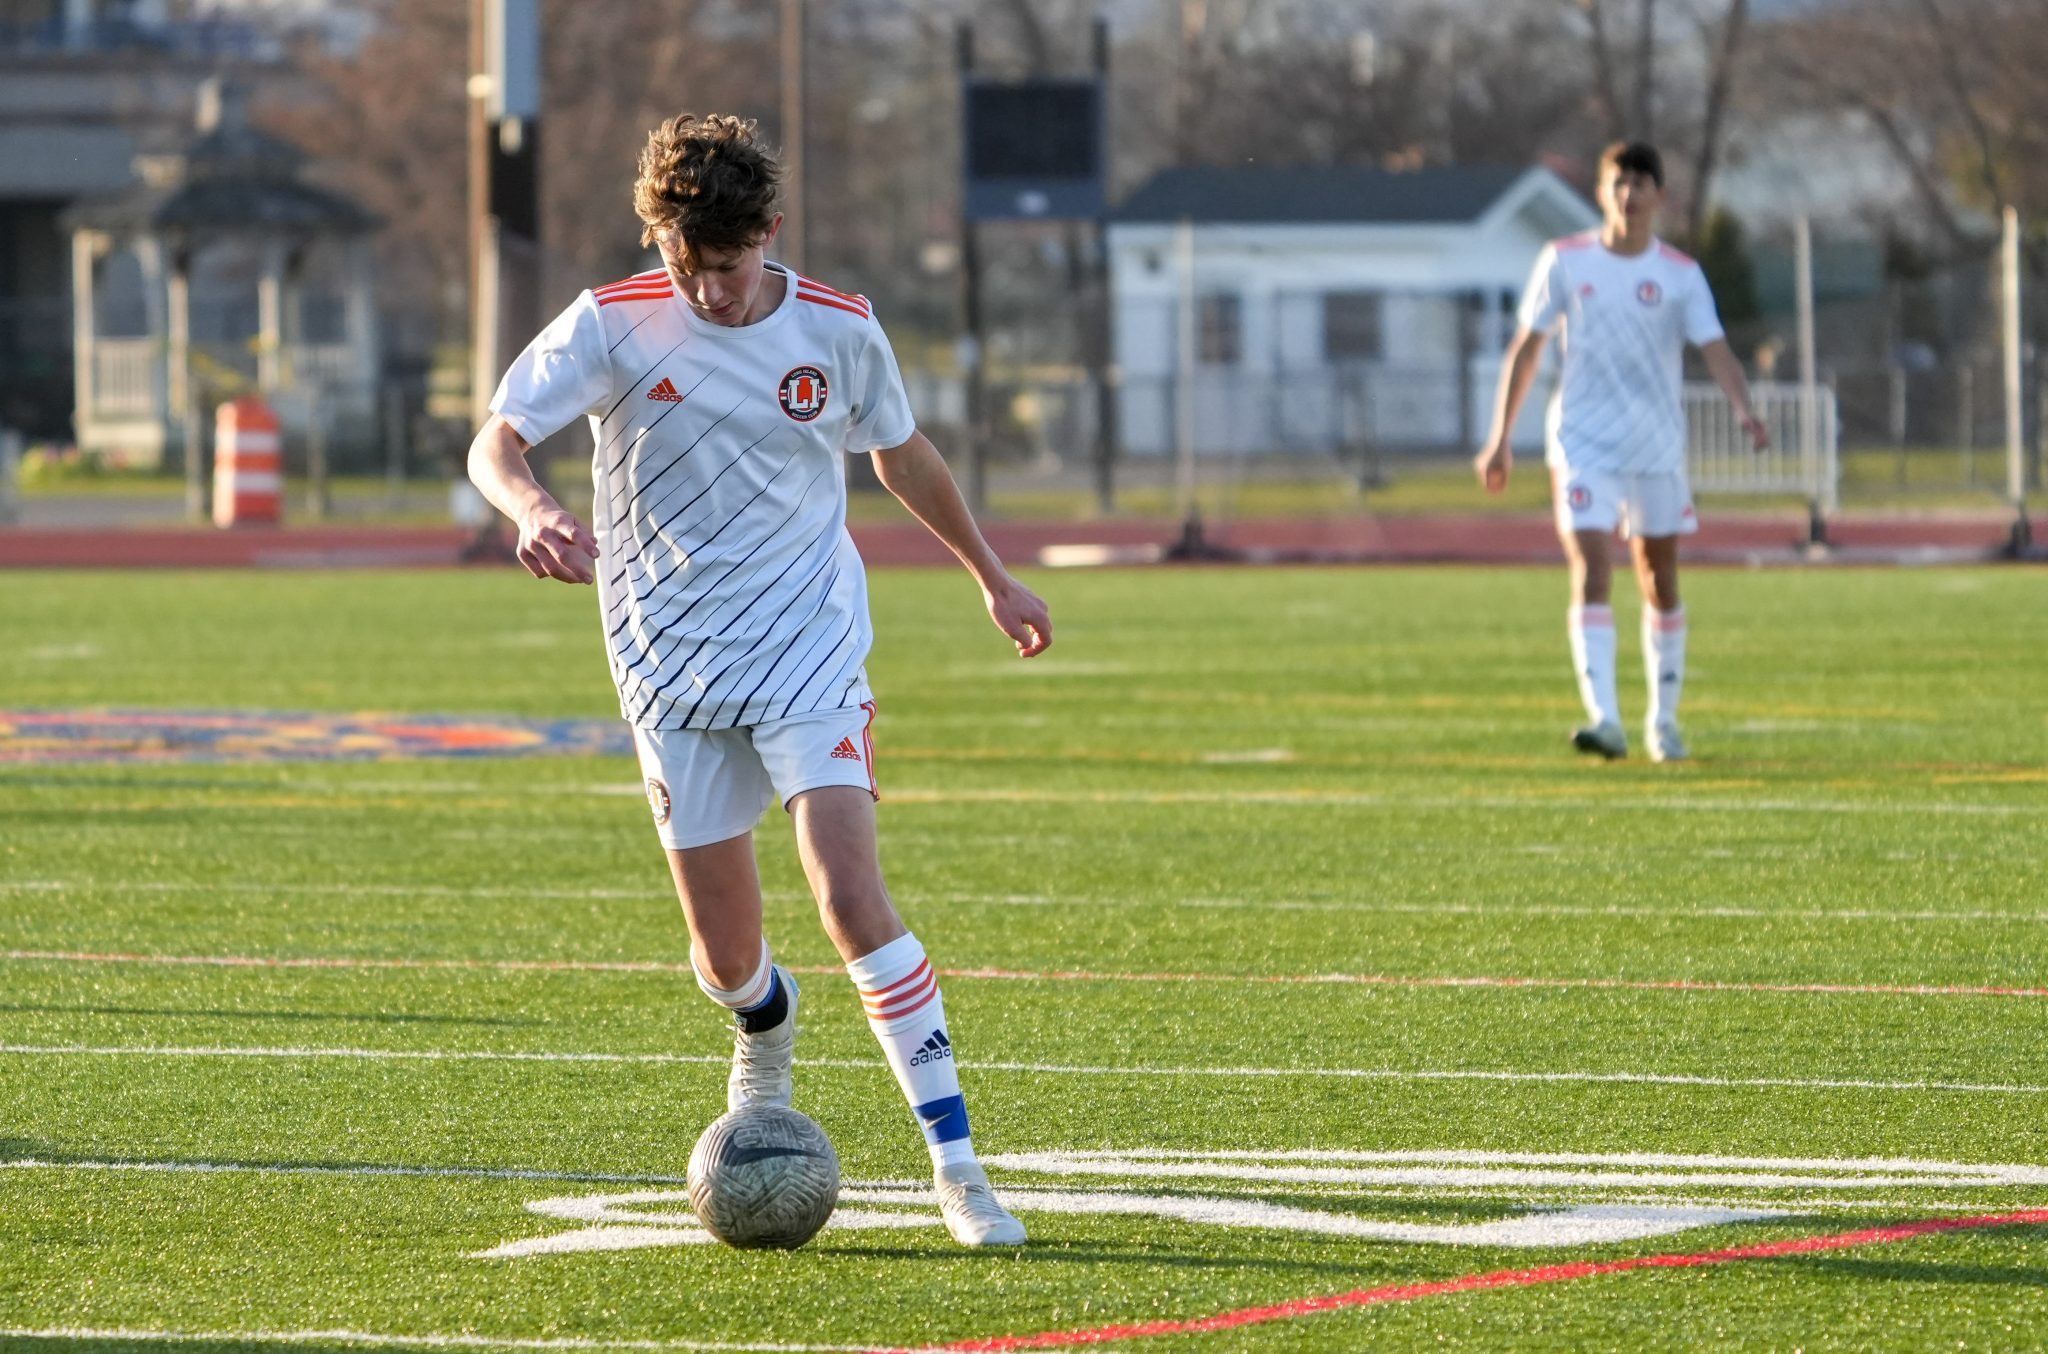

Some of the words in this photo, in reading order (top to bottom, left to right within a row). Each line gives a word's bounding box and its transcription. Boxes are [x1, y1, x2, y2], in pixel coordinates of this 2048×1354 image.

[647, 392, 683, 402] adidas
[789, 379, 819, 409] LI
[831, 750, 861, 761] adidas
[910, 1048, 951, 1066] adida
